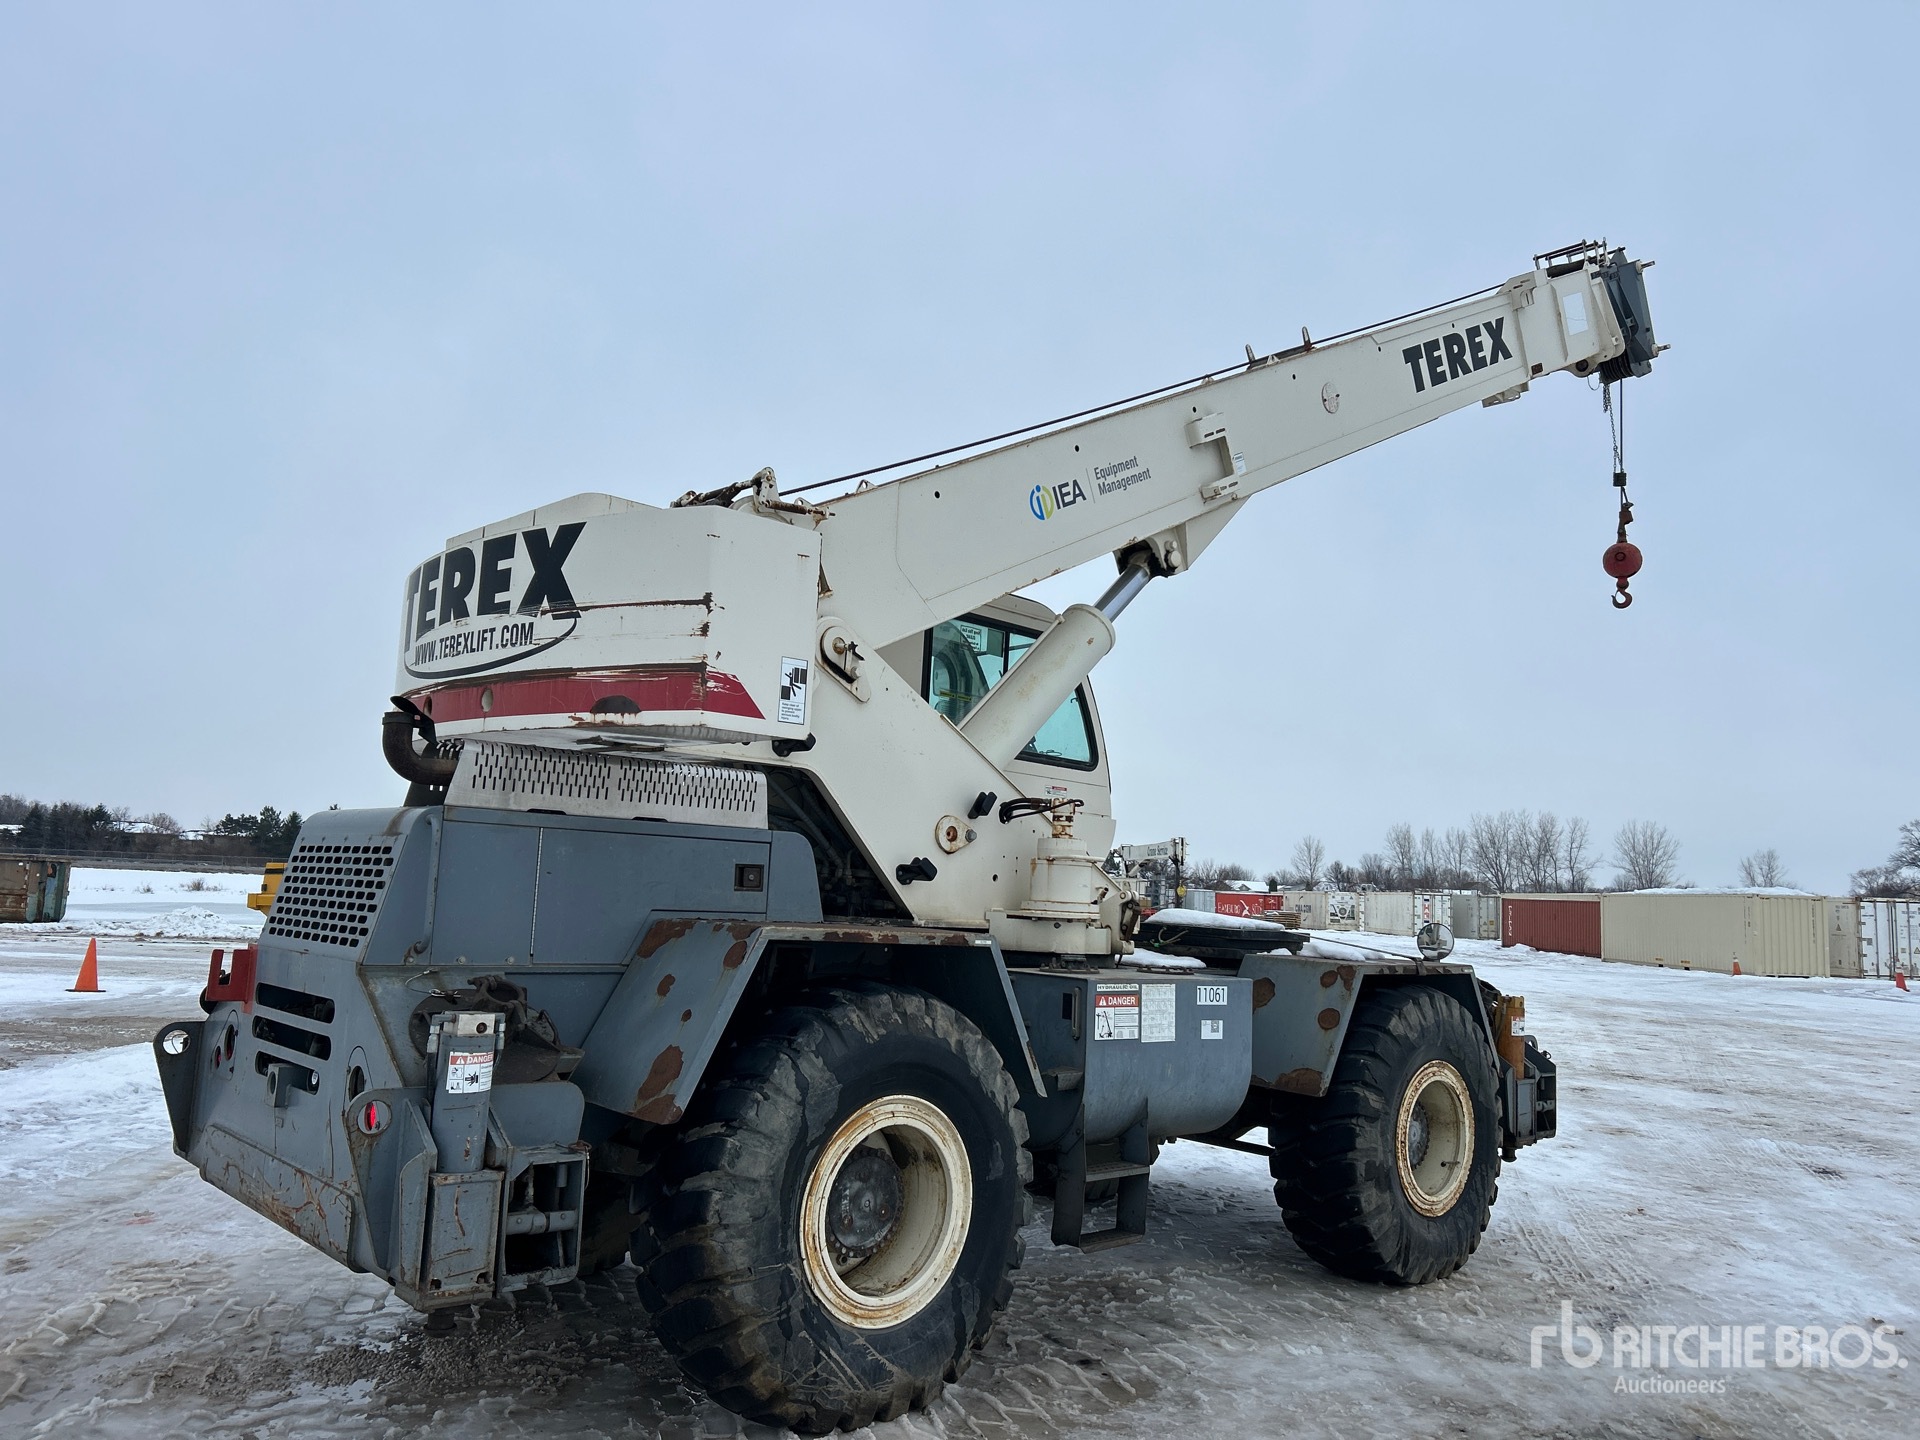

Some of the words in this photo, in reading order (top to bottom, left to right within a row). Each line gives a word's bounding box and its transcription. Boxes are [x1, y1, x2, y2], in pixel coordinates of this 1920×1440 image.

[1401, 316, 1513, 393] TEREX
[1093, 455, 1139, 481] Equipment
[1097, 467, 1152, 496] Management
[1051, 479, 1087, 510] IEA
[405, 522, 587, 653] TEREX
[414, 621, 535, 667] WWW.TEREXLIFT.COM
[1107, 996, 1136, 1006] DANGER
[1197, 987, 1226, 1003] 11061
